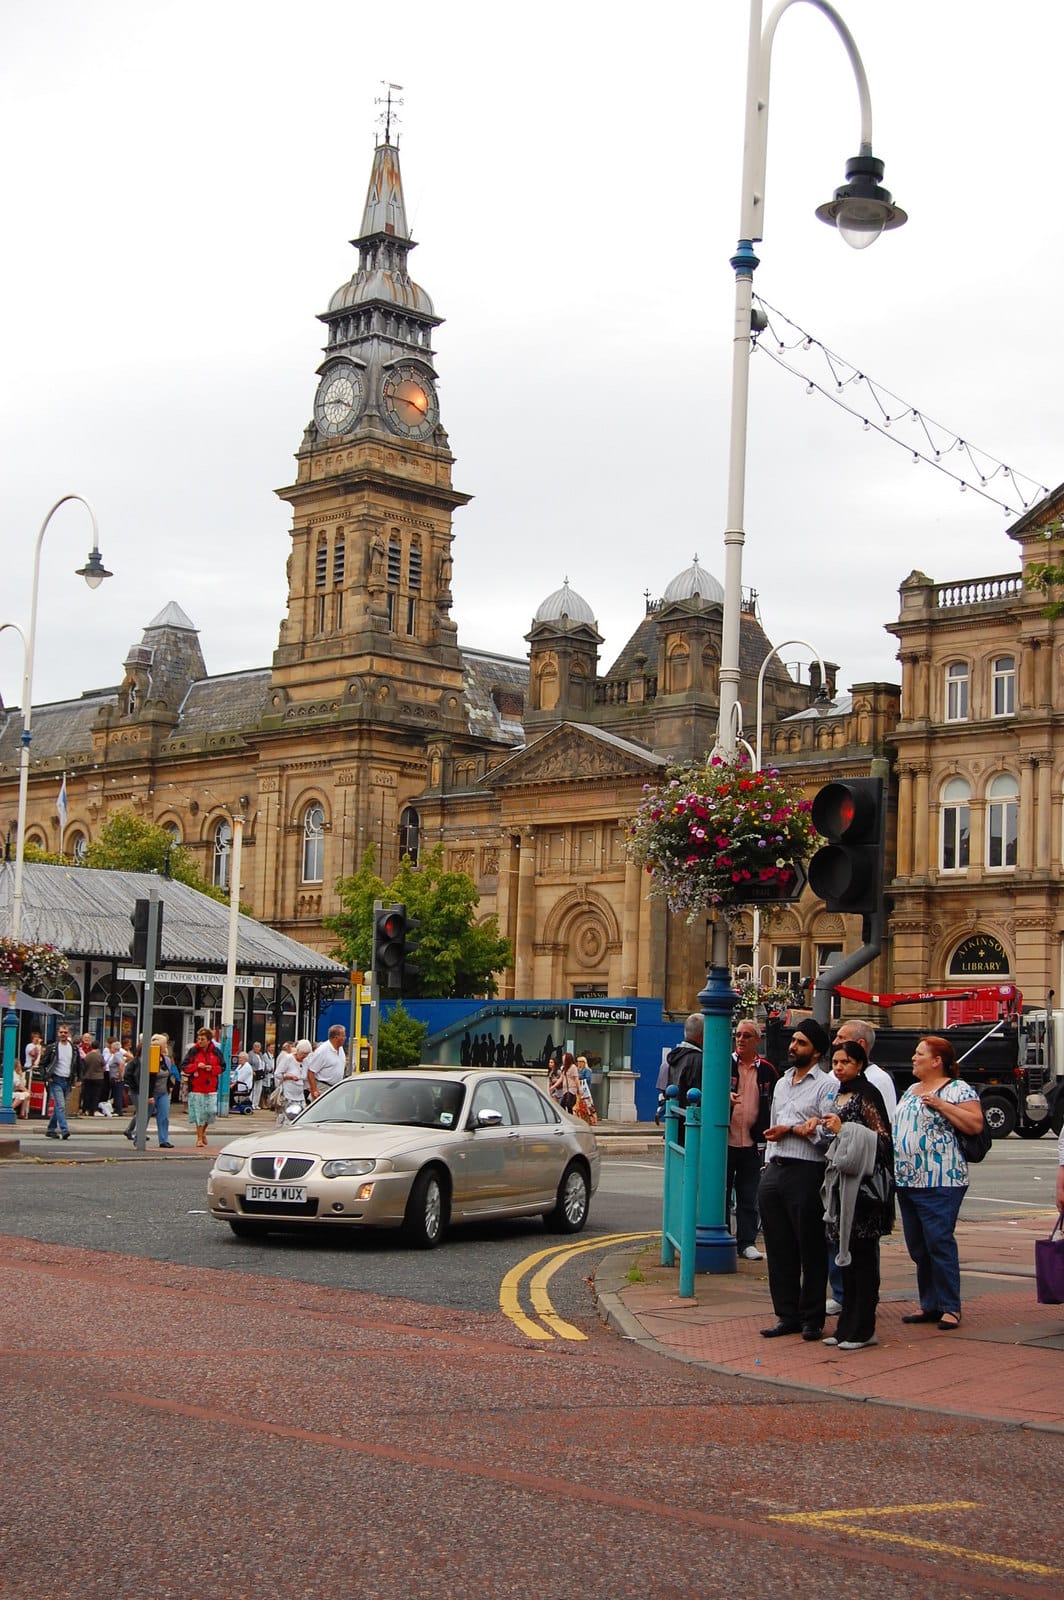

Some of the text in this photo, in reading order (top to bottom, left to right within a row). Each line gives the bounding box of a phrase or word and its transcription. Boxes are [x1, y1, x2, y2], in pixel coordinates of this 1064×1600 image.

[957, 937, 1006, 958] ATKINSON
[962, 962, 1000, 970] LIBRARY
[170, 972, 220, 984] INFORMATION
[574, 1008, 589, 1017] The
[611, 1010, 633, 1020] Cellar
[251, 1187, 303, 1200] DF04 WUX
